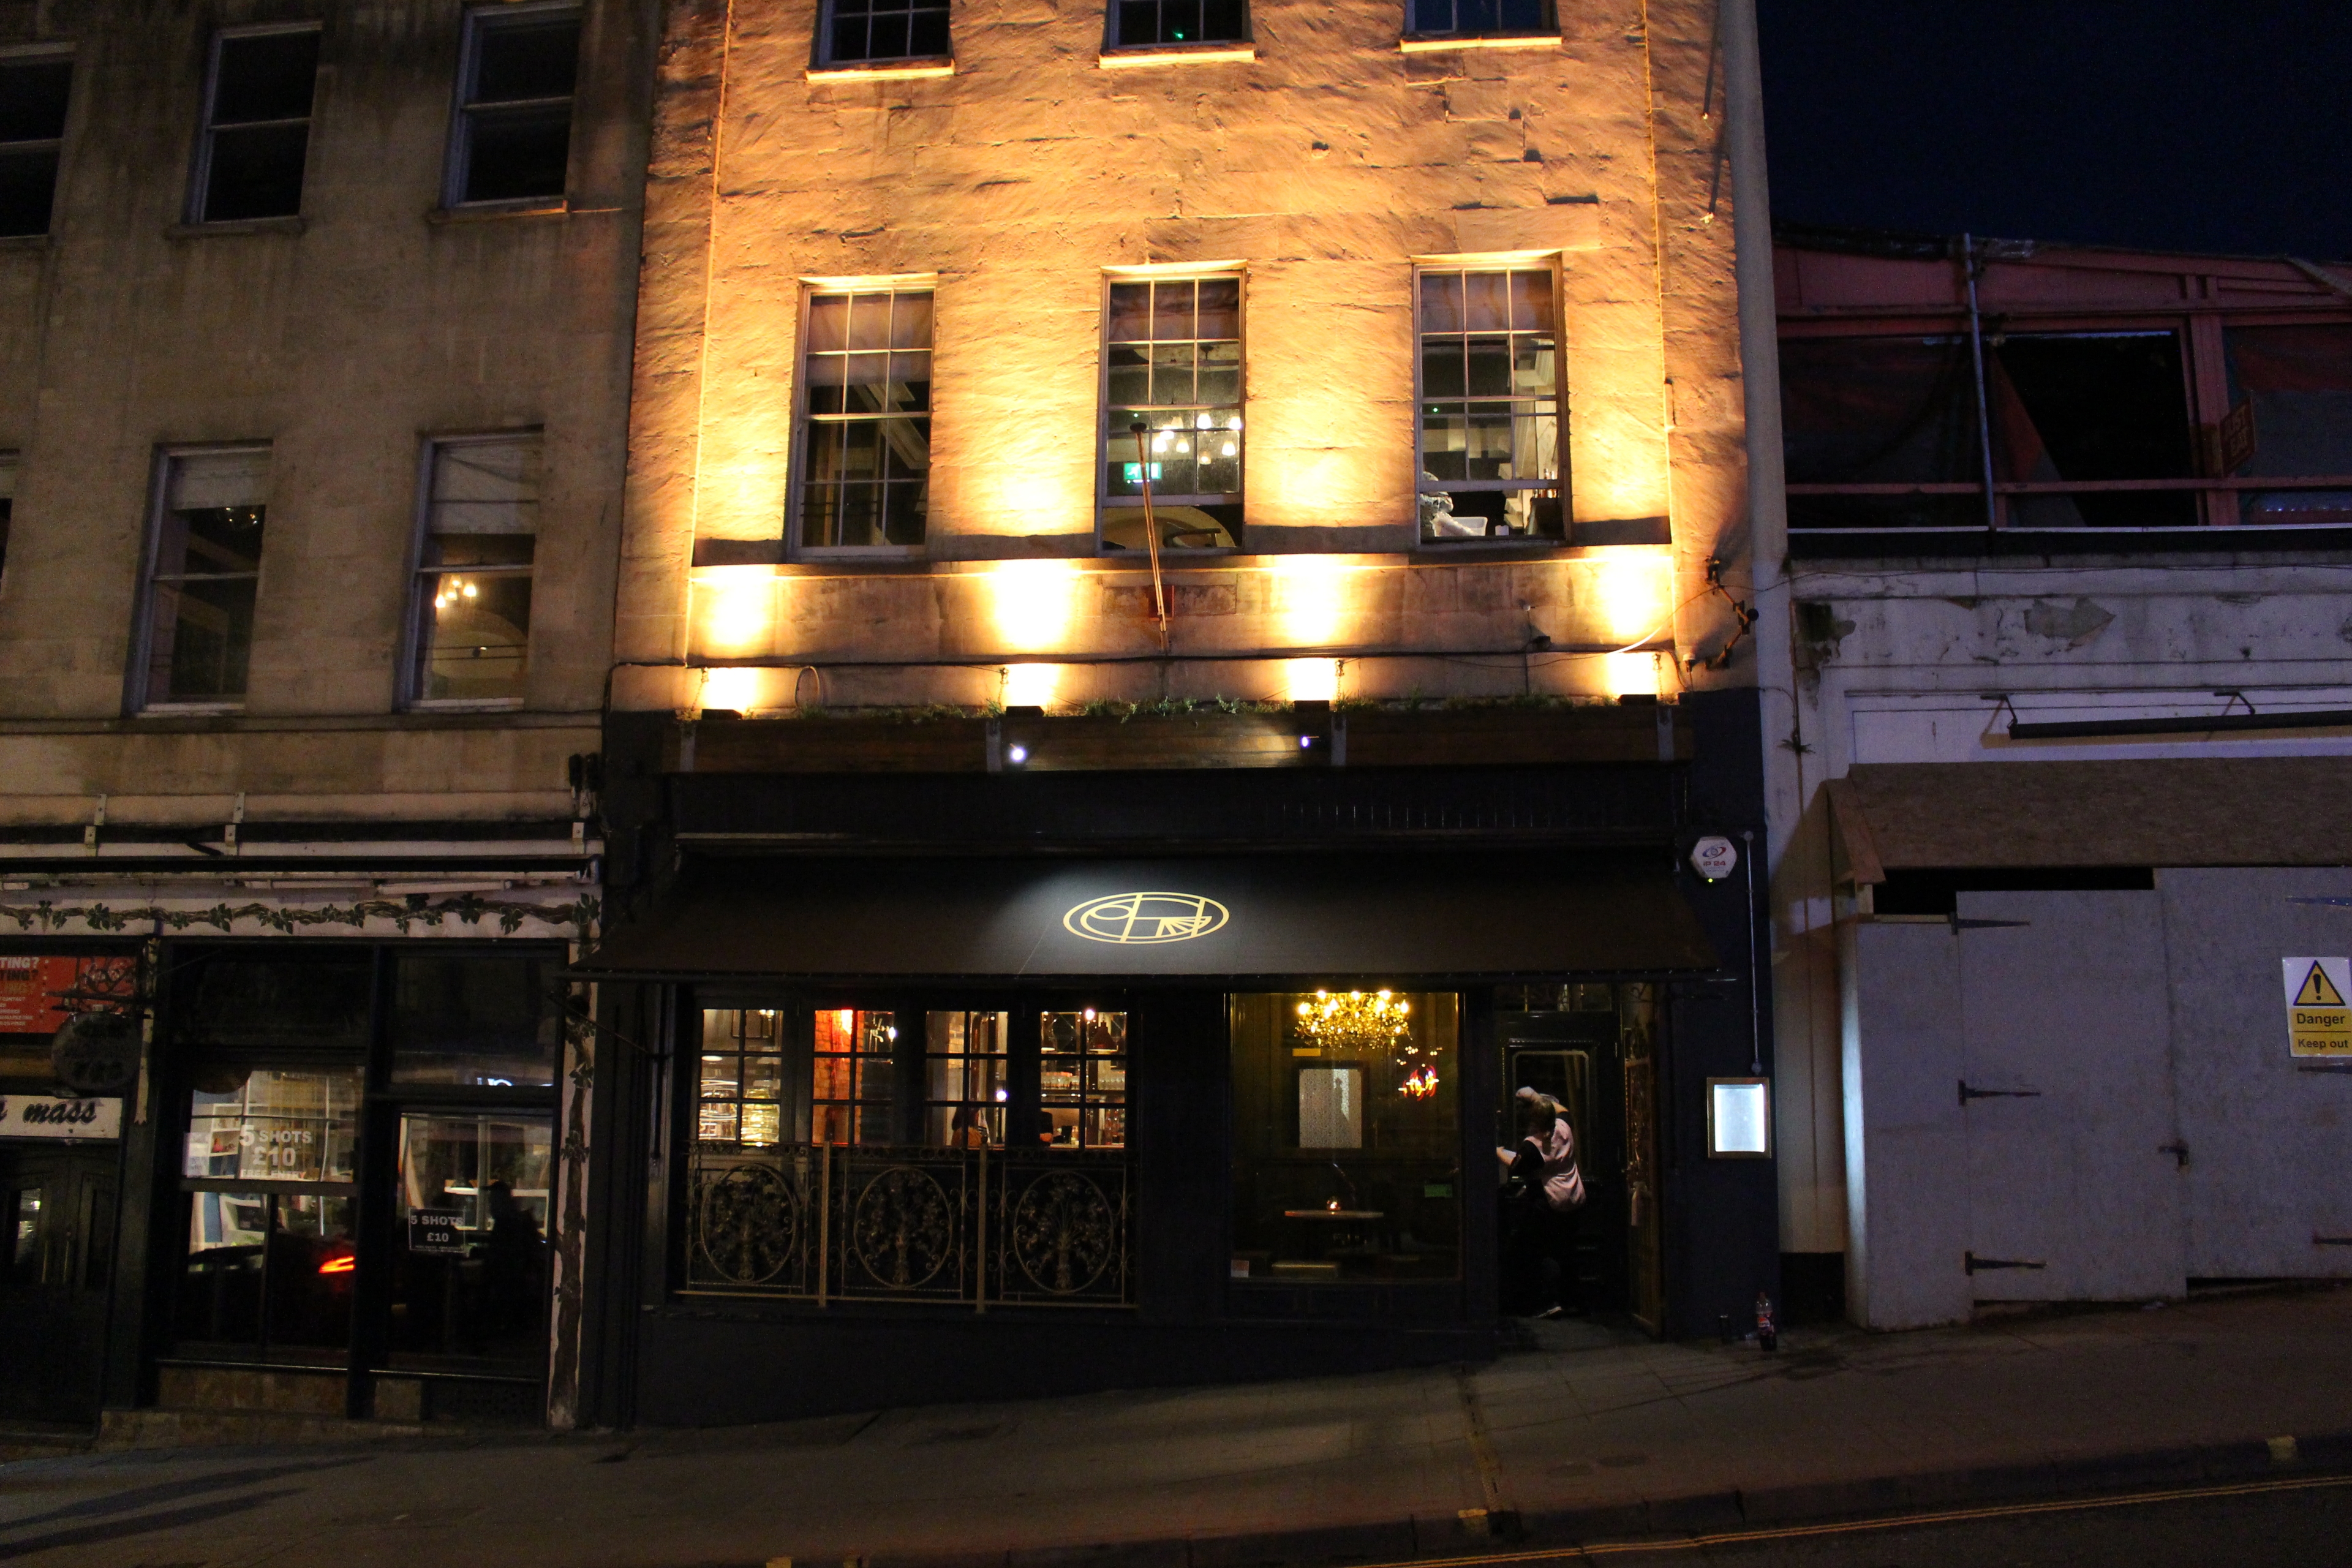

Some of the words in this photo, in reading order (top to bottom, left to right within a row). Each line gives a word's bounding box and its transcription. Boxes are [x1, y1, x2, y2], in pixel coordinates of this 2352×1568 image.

[2297, 1013, 2345, 1027] Danger
[2298, 1039, 2326, 1050] Keep
[2329, 1039, 2349, 1049] out
[23, 1100, 97, 1125] mass
[239, 1125, 255, 1146] 5
[258, 1130, 312, 1144] SHOTS
[252, 1147, 296, 1167] £10
[410, 1215, 418, 1225] 5
[421, 1215, 464, 1226] SHOTS
[426, 1232, 449, 1242] £10
